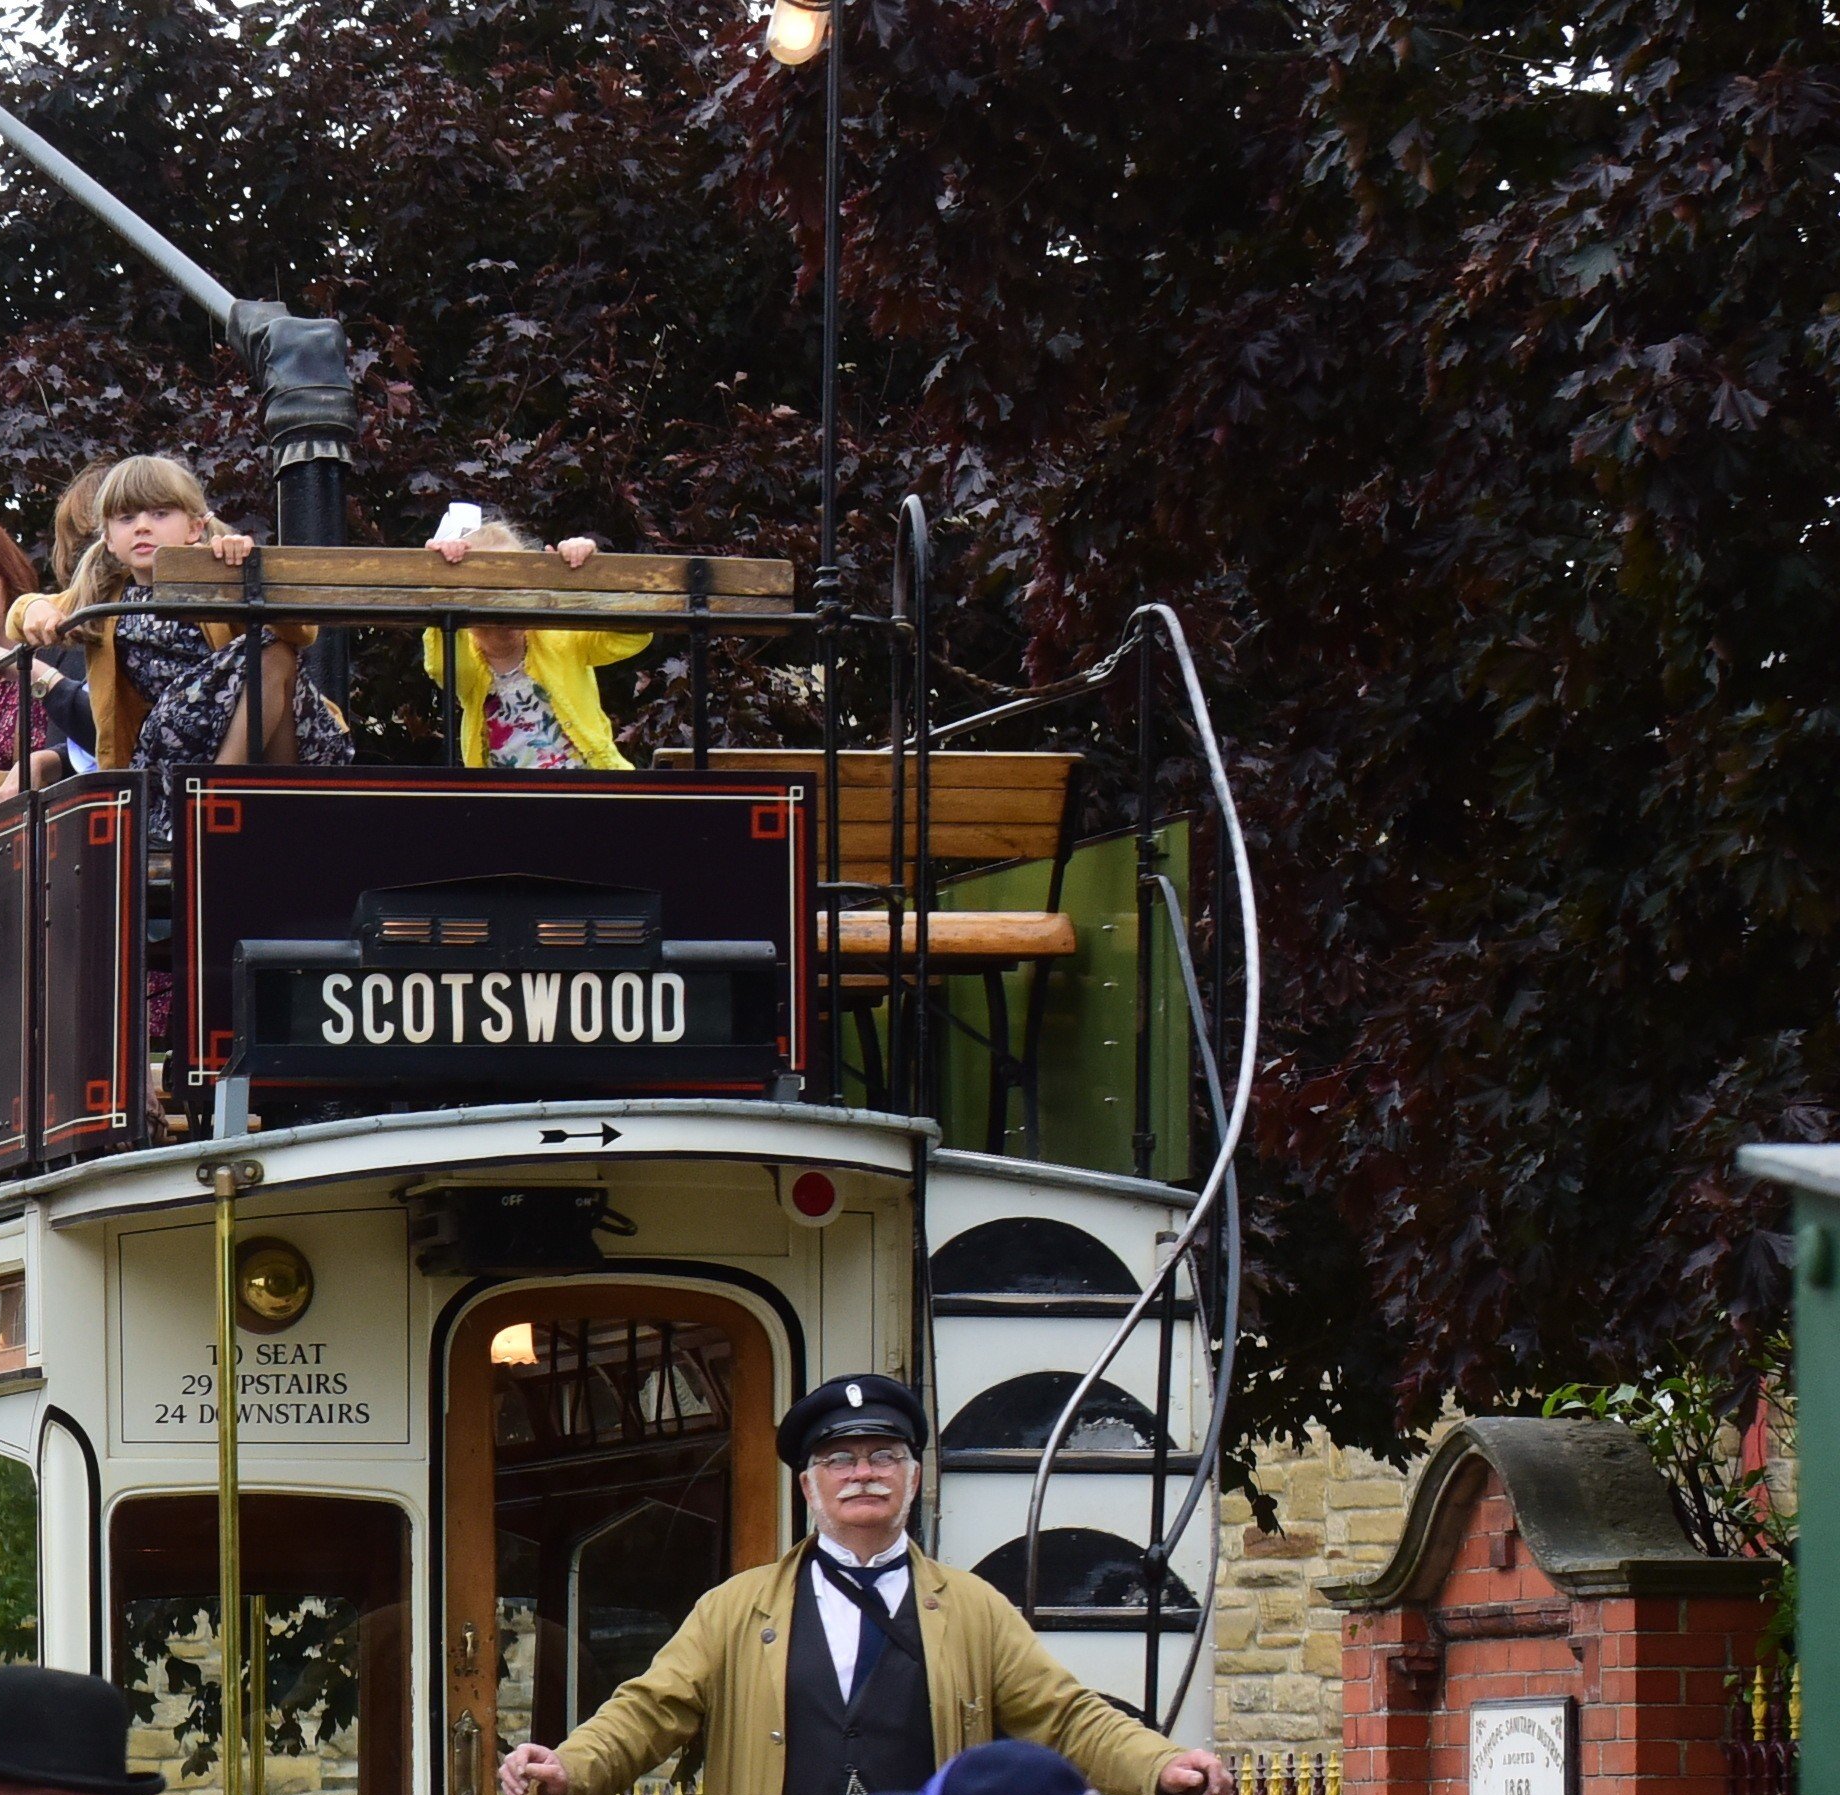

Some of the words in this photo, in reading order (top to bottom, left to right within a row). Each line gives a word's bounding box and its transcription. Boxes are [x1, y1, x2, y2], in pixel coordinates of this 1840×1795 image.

[321, 972, 686, 1044] SCOTSWOOD
[256, 1343, 328, 1365] SEAT
[182, 1374, 213, 1397] 29
[234, 1373, 348, 1396] PSTAIRS
[154, 1403, 188, 1424] 24
[199, 1402, 370, 1425] DWNSTAIRS
